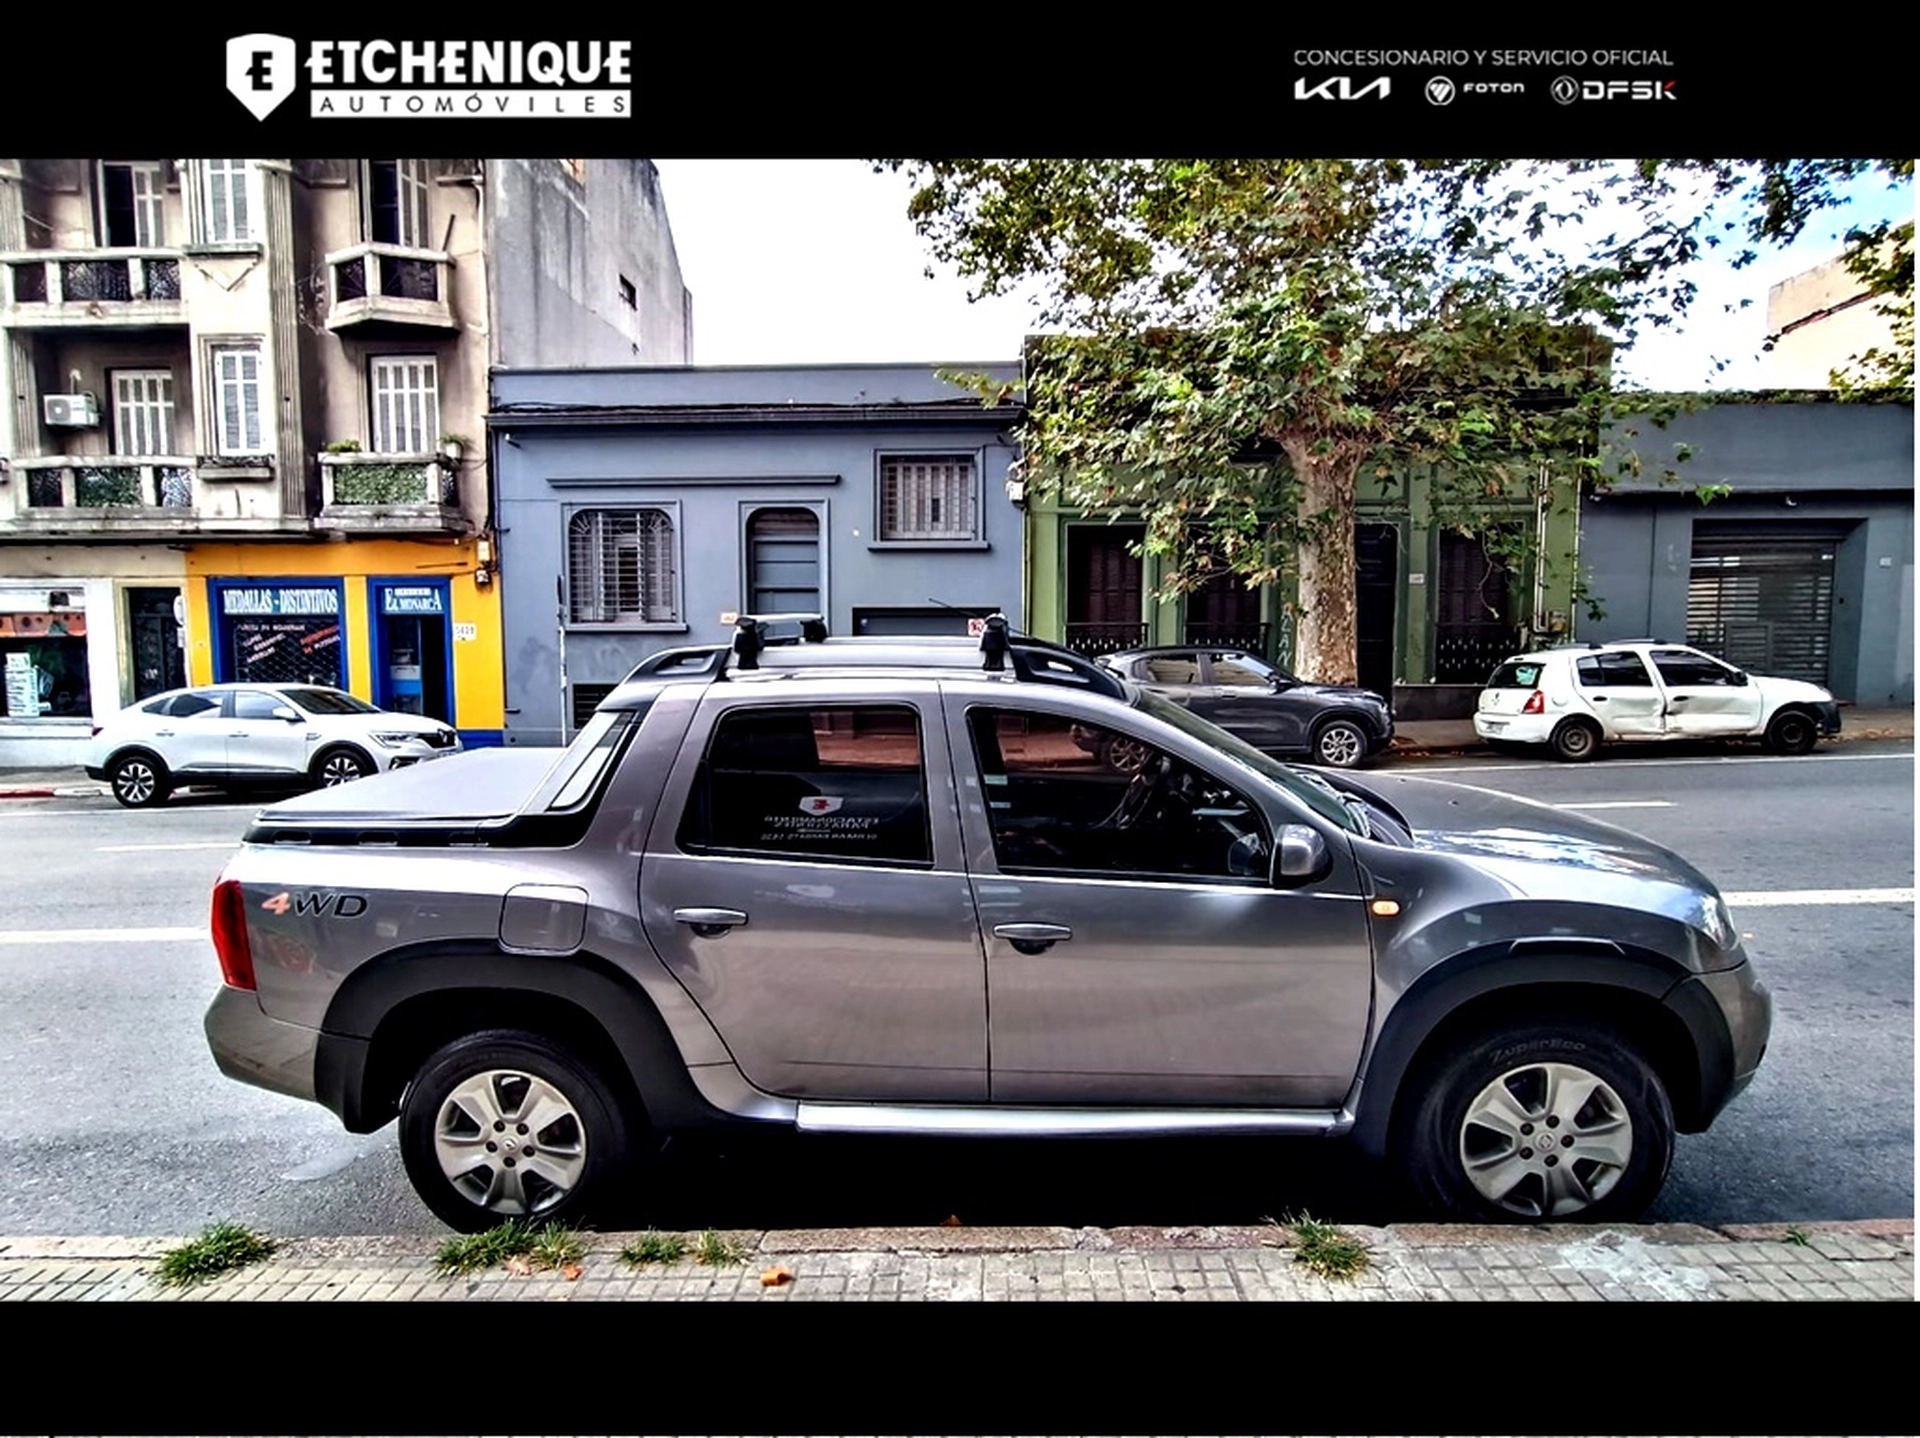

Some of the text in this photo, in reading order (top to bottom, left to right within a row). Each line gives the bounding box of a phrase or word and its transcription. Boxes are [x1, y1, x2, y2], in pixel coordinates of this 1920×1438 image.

[223, 589, 273, 614] MEDALLAS
[280, 589, 338, 614] DISTINTIVOS
[261, 892, 368, 919] 4WD
